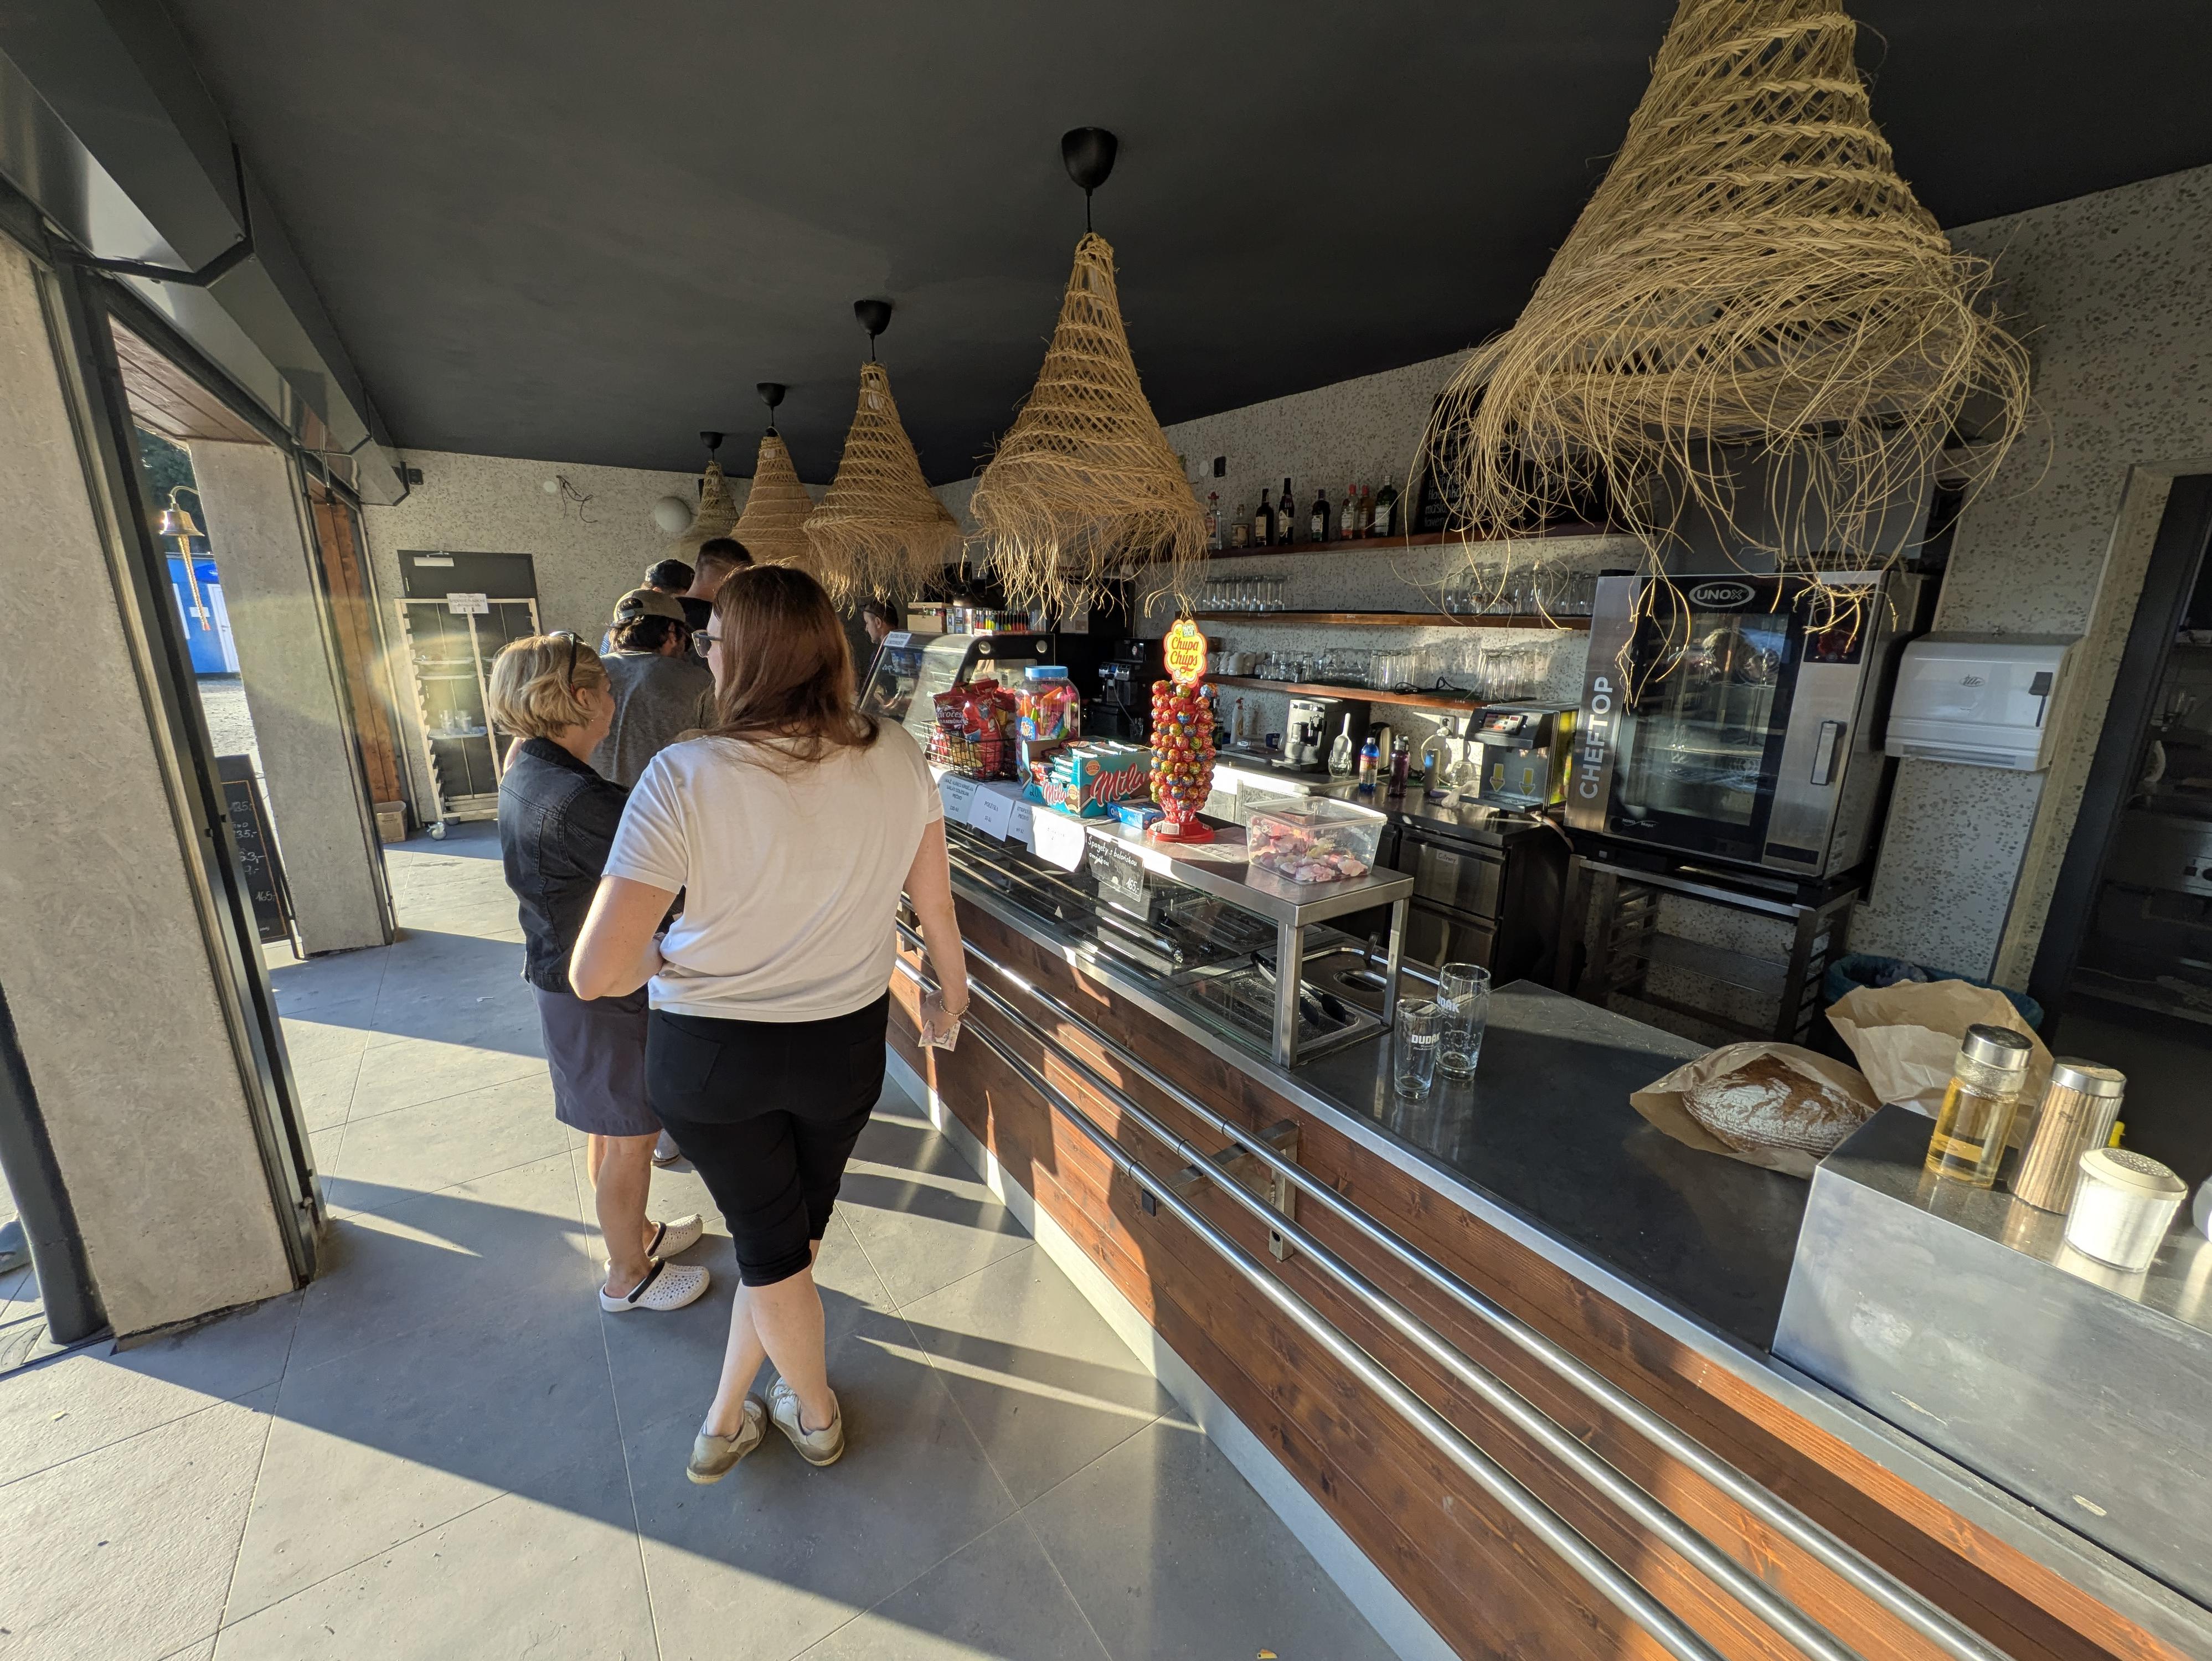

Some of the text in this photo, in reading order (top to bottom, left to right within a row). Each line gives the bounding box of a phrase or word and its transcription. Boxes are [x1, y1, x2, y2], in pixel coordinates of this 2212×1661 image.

[1697, 589, 1744, 600] UNOX
[1172, 637, 1199, 654] Chupa
[1171, 651, 1198, 669] Chups
[1580, 677, 1613, 798] CHEFTOP
[1042, 781, 1068, 806] Mila
[1090, 762, 1149, 807] Mila
[1126, 878, 1139, 893] 165,-
